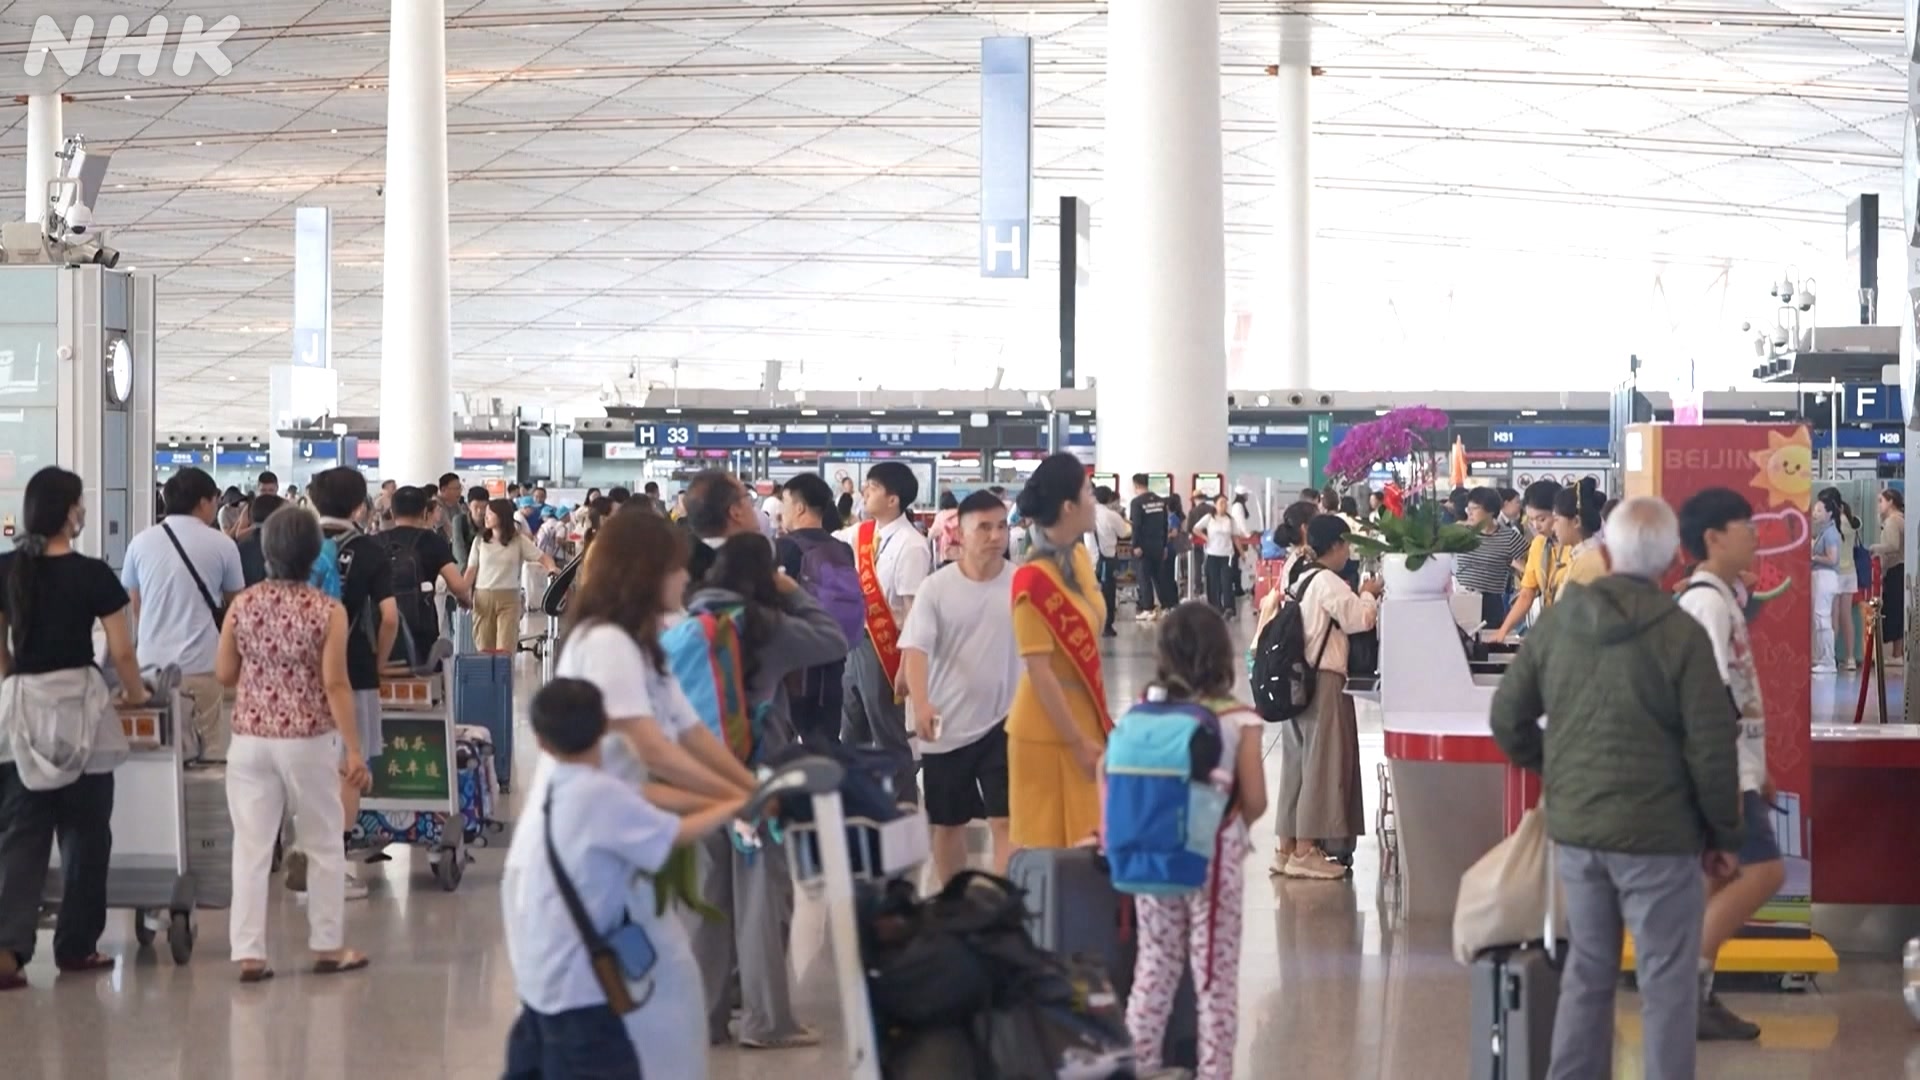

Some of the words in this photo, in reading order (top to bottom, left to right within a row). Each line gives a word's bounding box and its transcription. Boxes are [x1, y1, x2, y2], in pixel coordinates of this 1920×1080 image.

[986, 225, 1021, 271] H
[301, 332, 319, 363] J
[1856, 387, 1877, 417] F
[639, 426, 655, 444] H
[667, 427, 689, 443] 33
[1493, 431, 1514, 443] H31
[303, 442, 313, 457] J
